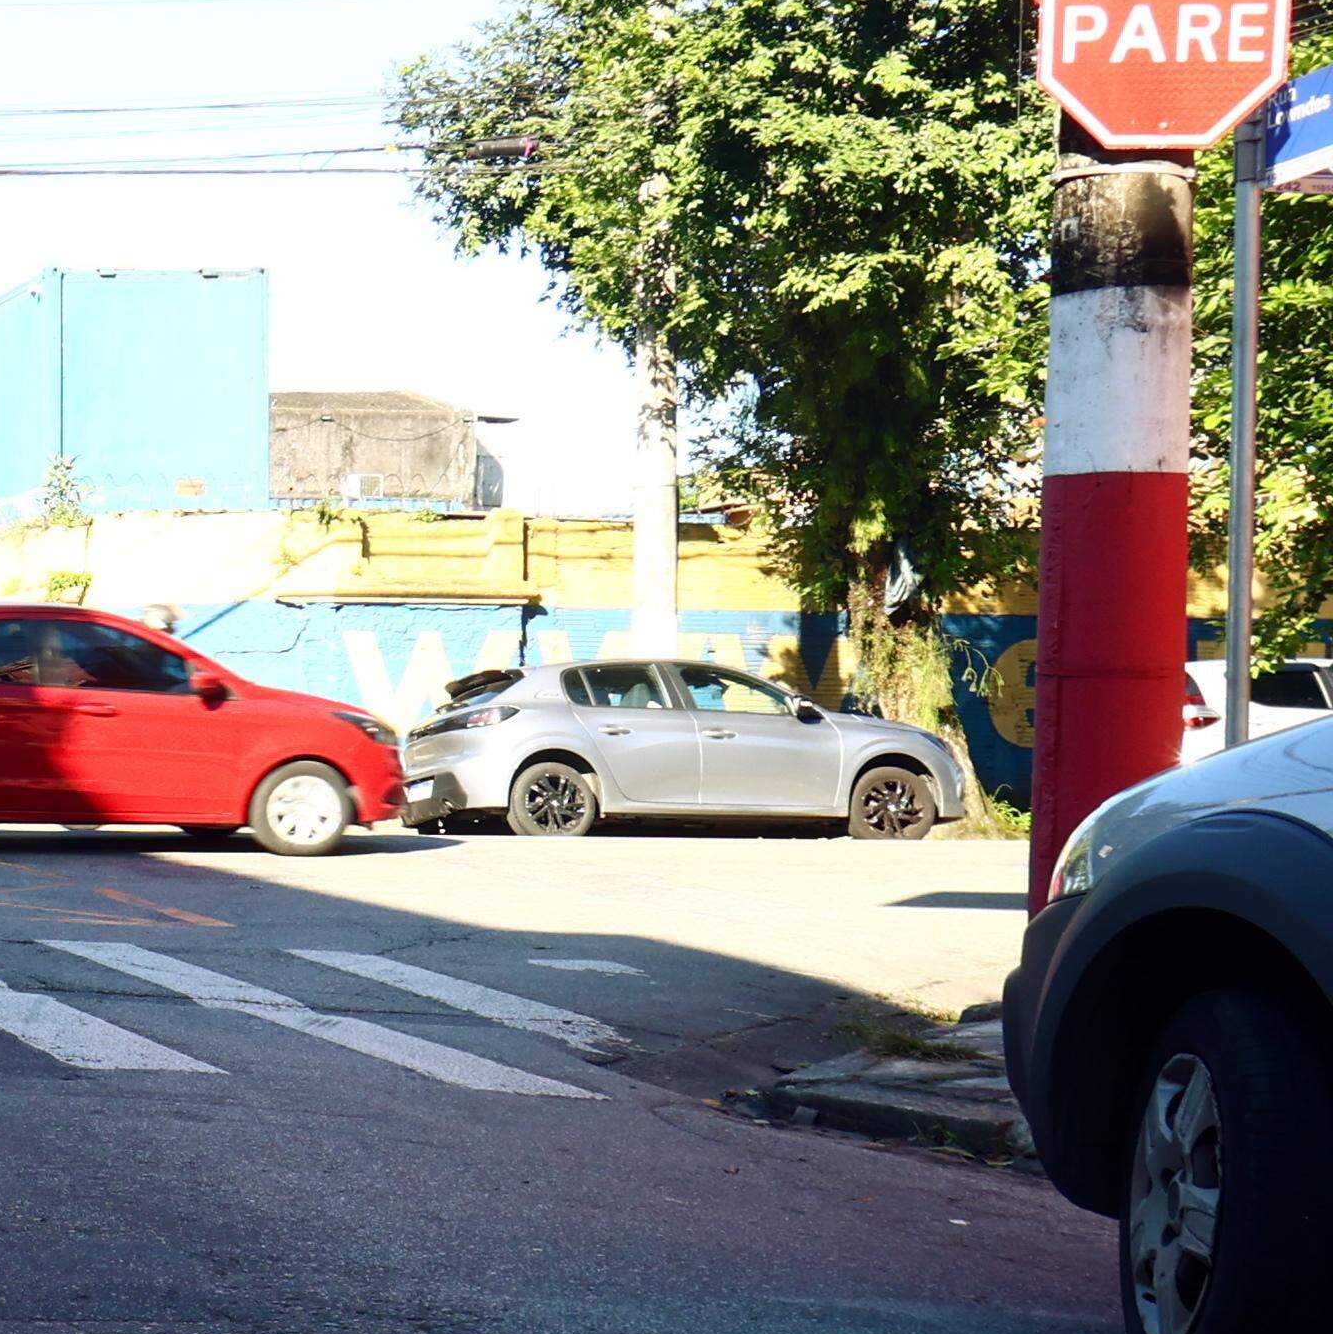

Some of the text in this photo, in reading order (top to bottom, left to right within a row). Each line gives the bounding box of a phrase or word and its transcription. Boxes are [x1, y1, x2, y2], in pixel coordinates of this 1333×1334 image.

[1061, 3, 1269, 64] PARE
[1267, 87, 1297, 109] Rua
[1267, 94, 1331, 128] Lowndes
